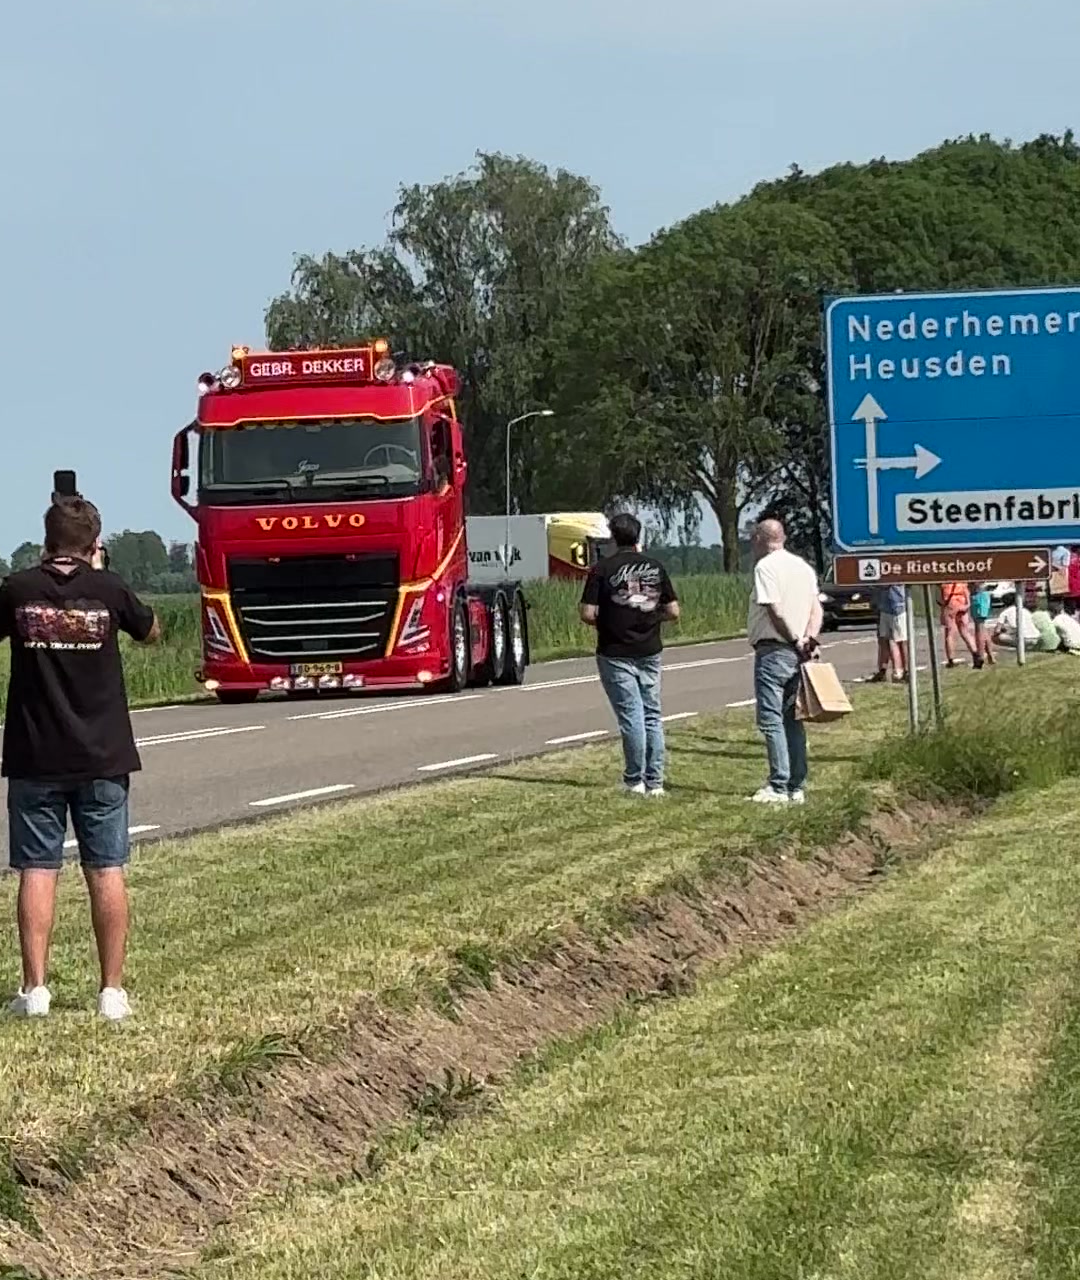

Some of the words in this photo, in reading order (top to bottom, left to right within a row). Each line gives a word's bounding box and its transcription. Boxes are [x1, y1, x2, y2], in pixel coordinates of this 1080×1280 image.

[250, 362, 297, 376] GEBR.
[302, 358, 365, 373] DEKKER
[850, 350, 1012, 380] Heusden
[256, 513, 366, 531] VOLVO
[880, 562, 902, 575] De
[906, 558, 993, 574] Rietschoof
